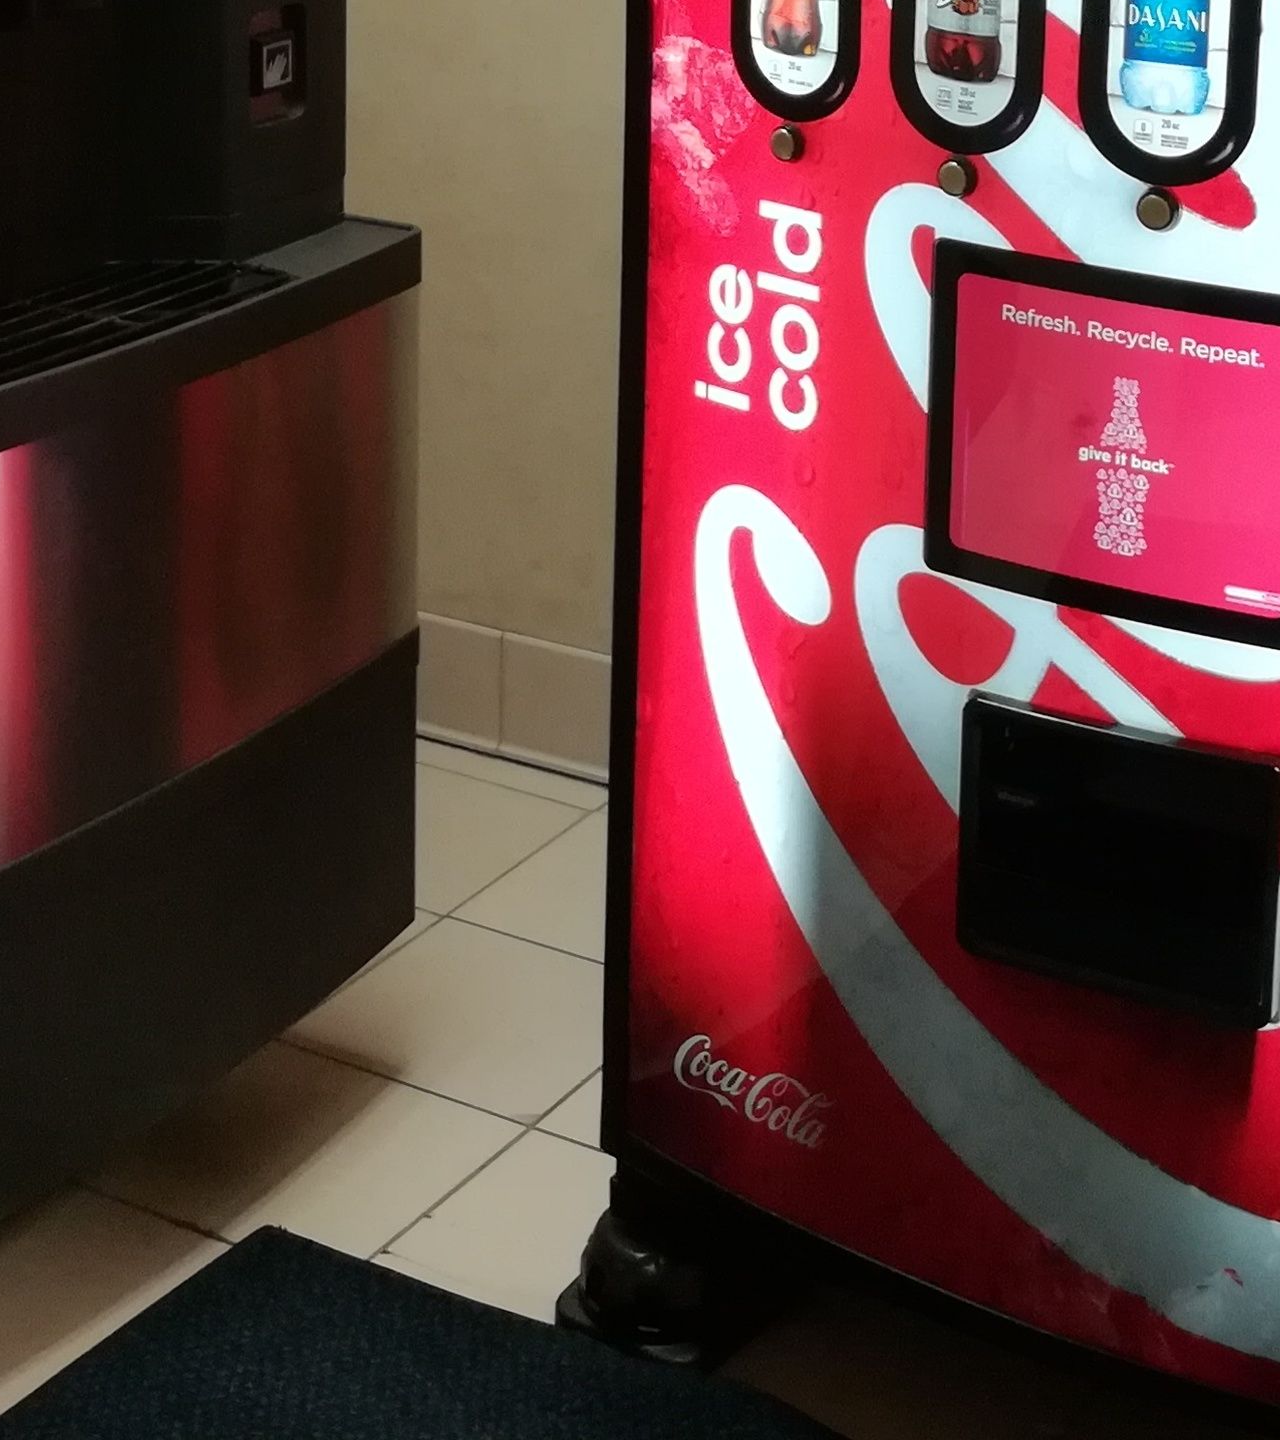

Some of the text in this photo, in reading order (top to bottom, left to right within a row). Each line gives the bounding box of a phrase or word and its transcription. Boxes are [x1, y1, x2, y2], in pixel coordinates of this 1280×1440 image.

[1129, 2, 1206, 33] DASANI
[1161, 119, 1171, 129] 20
[694, 263, 753, 412] ice
[757, 199, 823, 431] cold
[1001, 303, 1265, 368] Refresh. Recycle. Repeat.
[1078, 444, 1112, 463] give
[1115, 451, 1128, 466] it
[673, 1034, 835, 1148] Coca-Cola
